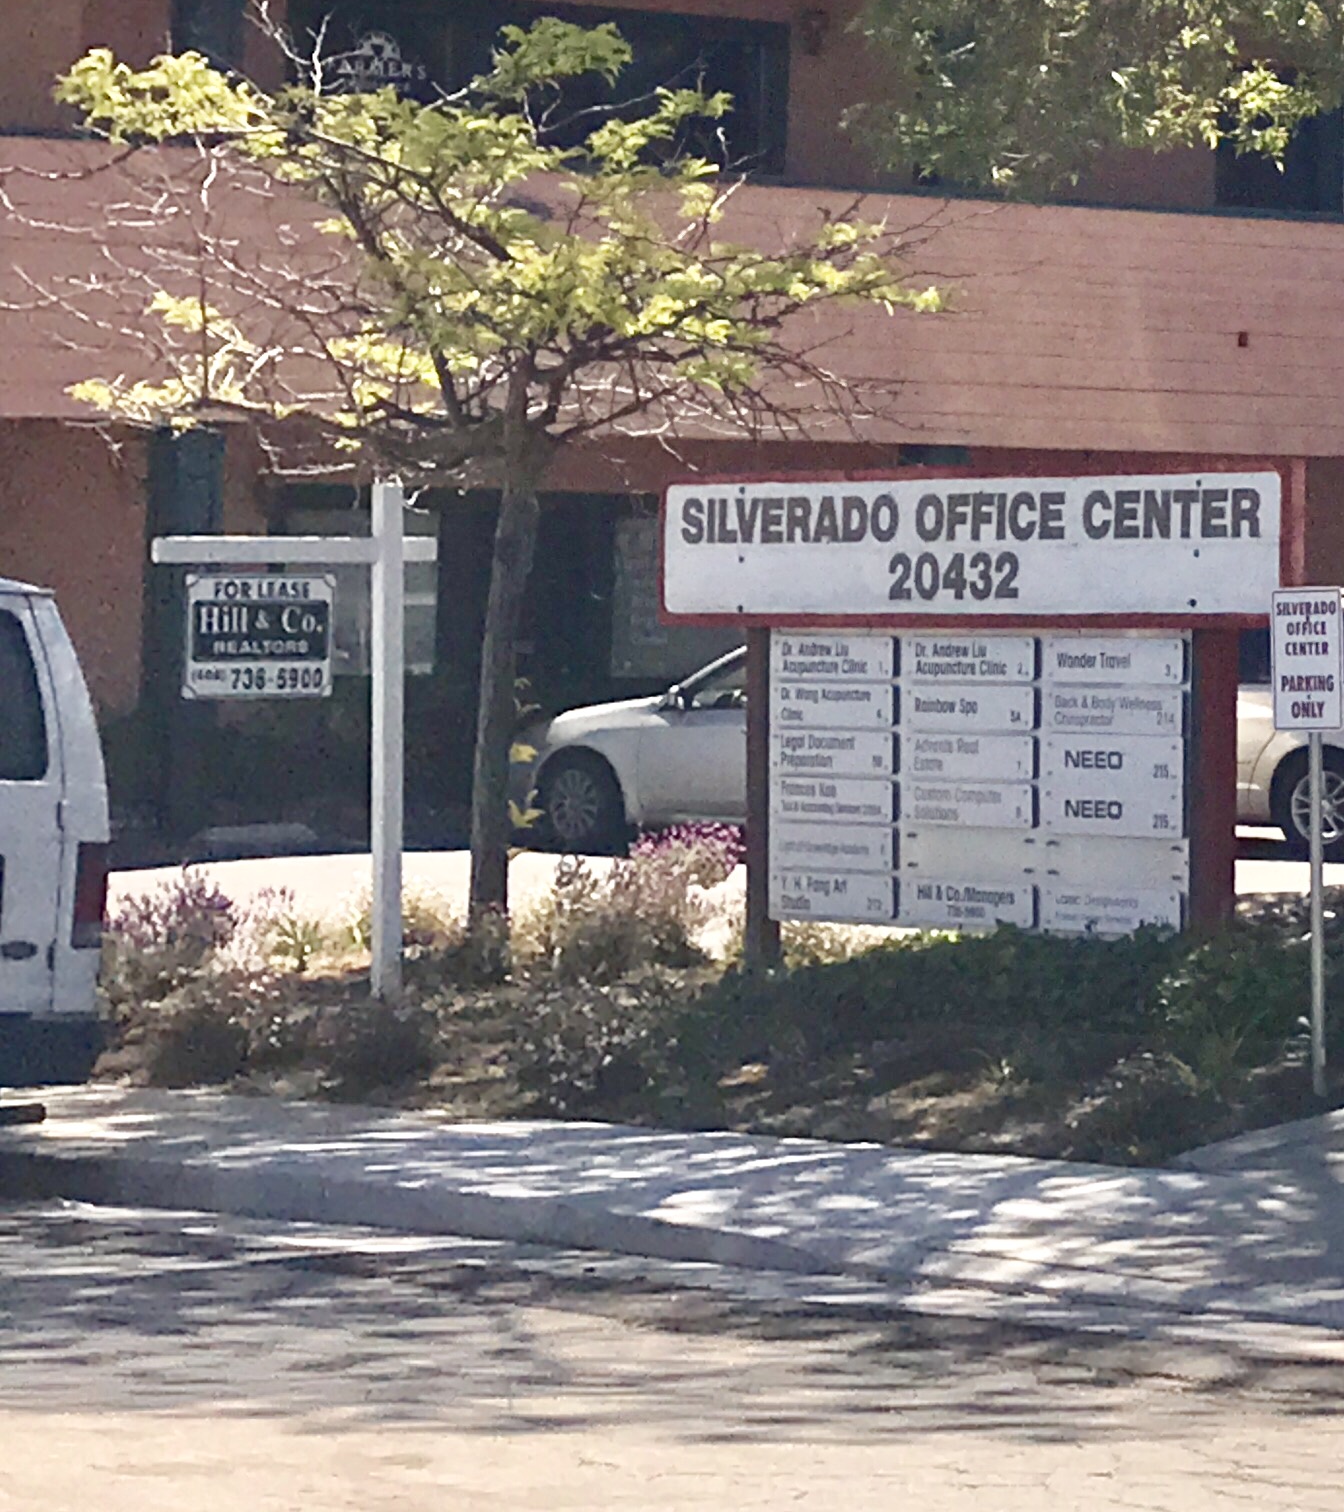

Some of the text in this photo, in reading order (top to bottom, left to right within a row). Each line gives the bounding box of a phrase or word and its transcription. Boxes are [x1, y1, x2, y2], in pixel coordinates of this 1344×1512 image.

[681, 487, 1262, 544] SILVERADO OFFICE CENTER
[888, 551, 1020, 601] 20432
[214, 581, 310, 599] FOR LEASE
[1276, 600, 1337, 616] SILVERADO
[200, 605, 323, 635] Hill & Co.
[1286, 621, 1327, 636] OFFICE
[213, 639, 309, 656] REALTORS
[932, 642, 970, 658] Andrew
[972, 640, 987, 658] Liu
[1284, 641, 1329, 656] CENTER
[915, 659, 976, 677] Acupuncture
[979, 659, 1008, 676] Clinic
[1281, 674, 1334, 693] PARKING
[1291, 701, 1325, 719] ONLY
[1064, 750, 1123, 770] NEEO
[1064, 799, 1123, 820] NEEO
